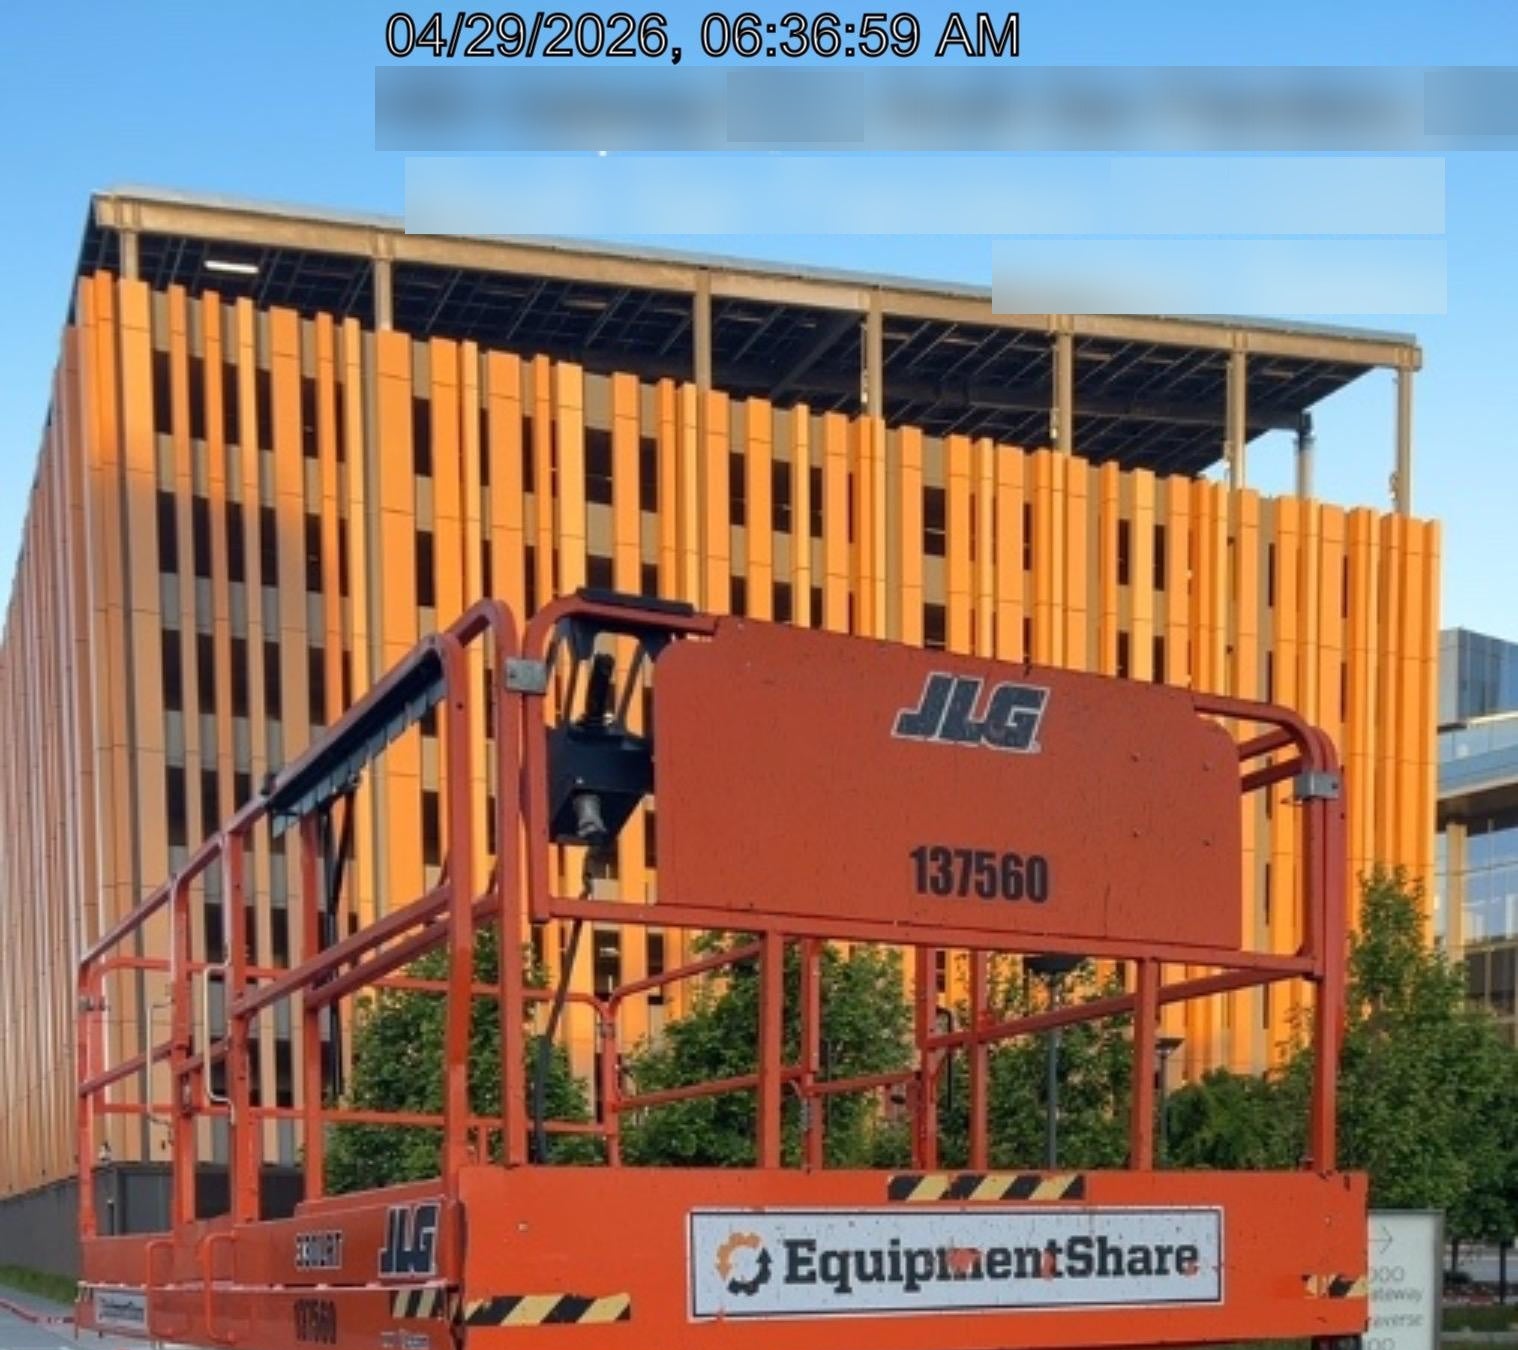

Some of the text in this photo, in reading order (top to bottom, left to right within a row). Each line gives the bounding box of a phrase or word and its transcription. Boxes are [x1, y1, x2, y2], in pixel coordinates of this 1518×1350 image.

[891, 672, 1049, 753] JLG
[910, 845, 1049, 903] 137560
[379, 1203, 440, 1278] JLG
[783, 1235, 1198, 1294] EquipmentShare
